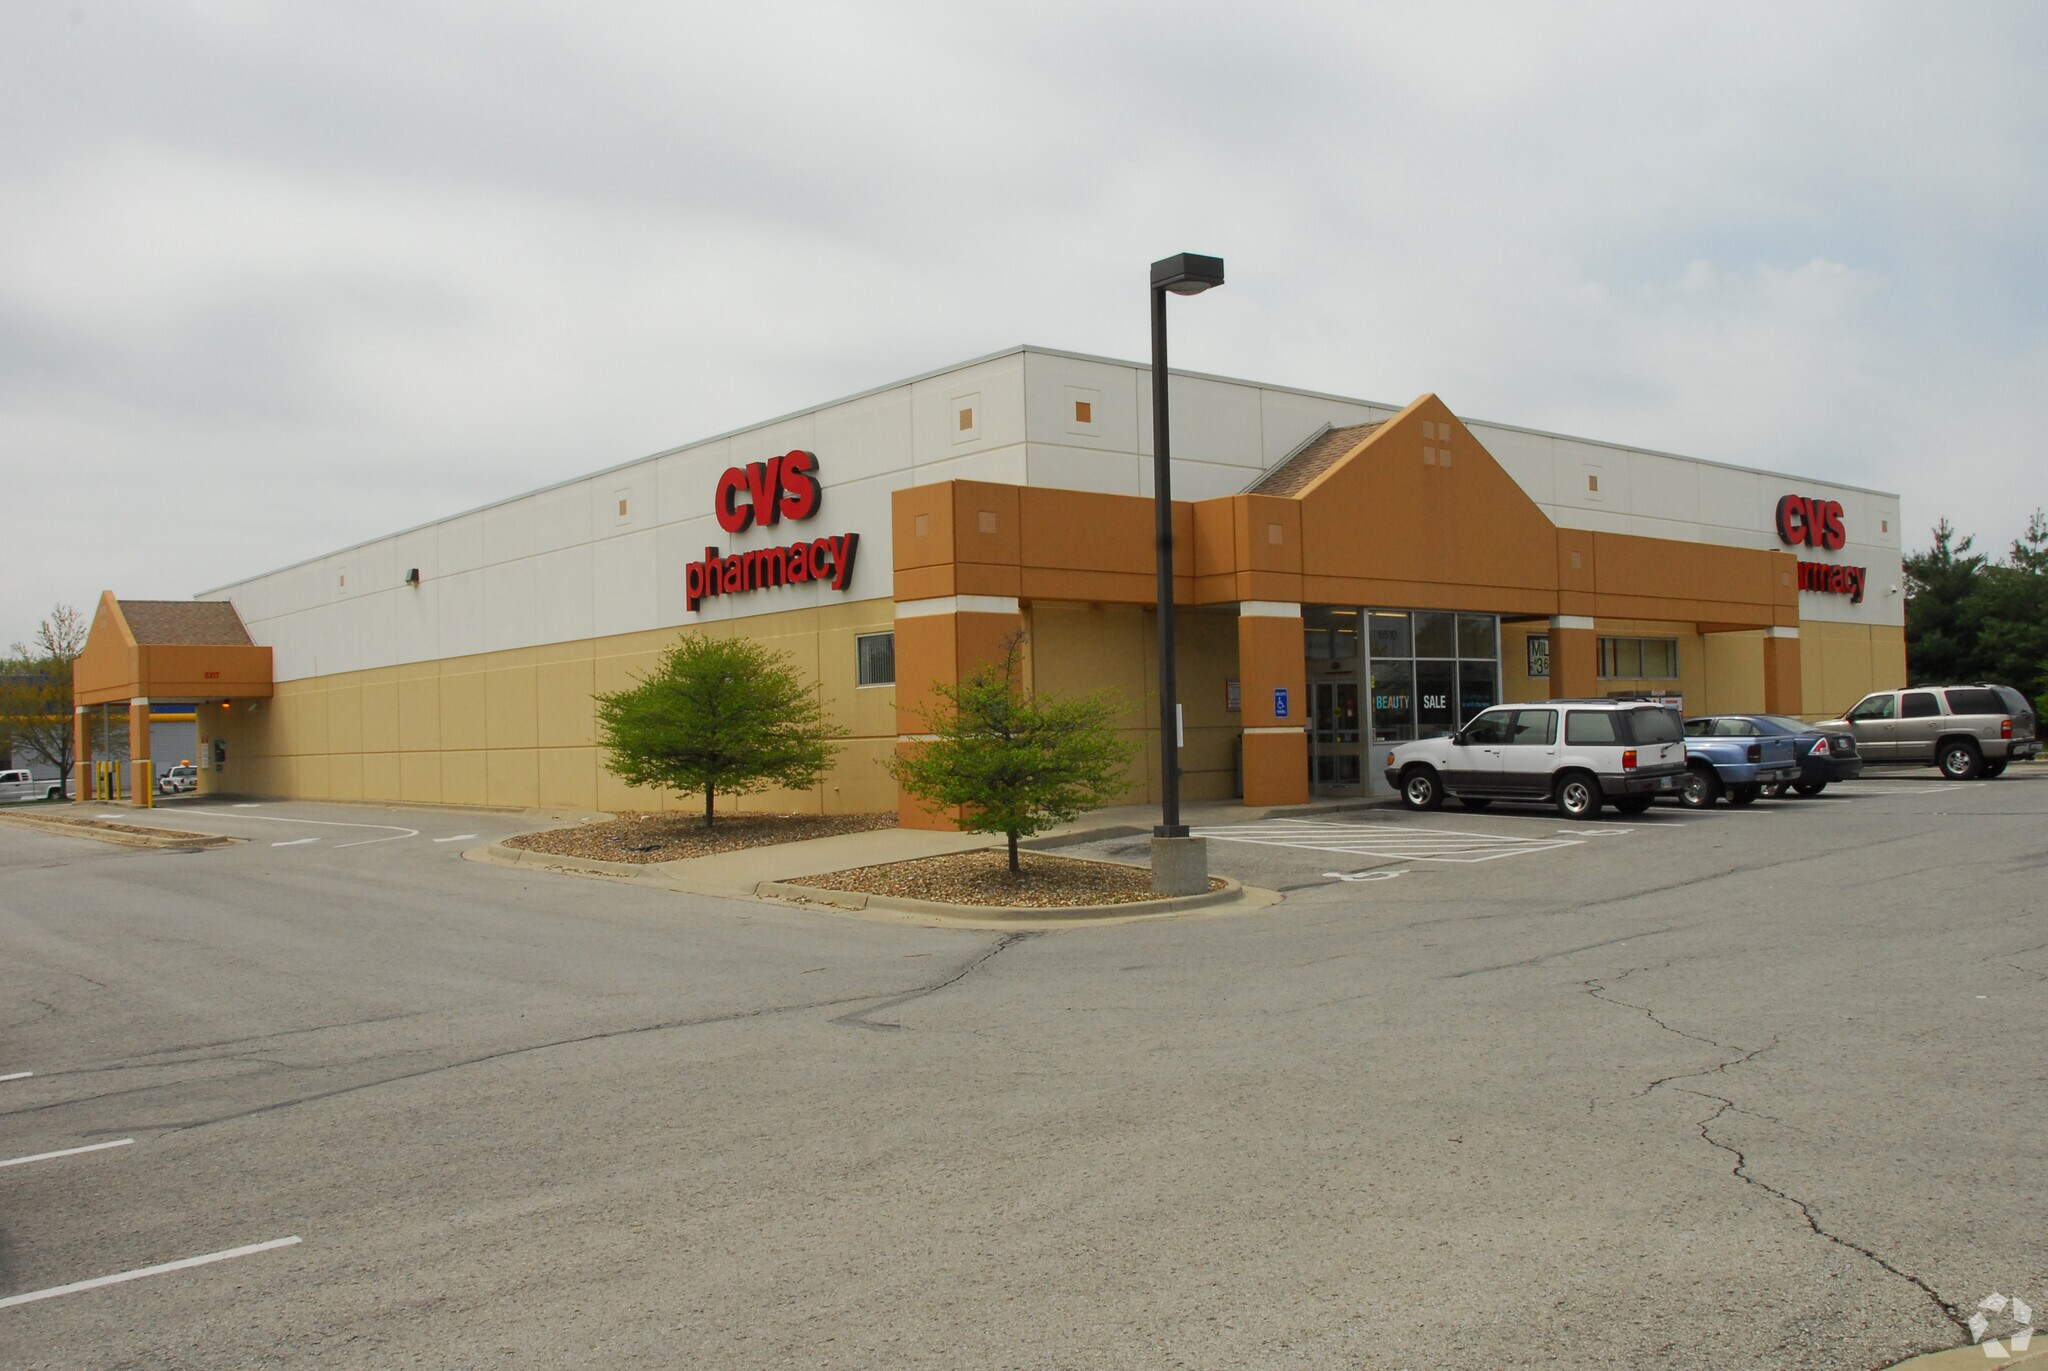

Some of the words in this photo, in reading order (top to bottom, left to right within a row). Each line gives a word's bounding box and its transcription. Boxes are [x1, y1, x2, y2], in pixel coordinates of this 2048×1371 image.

[715, 449, 822, 533] CVS
[1776, 494, 1846, 550] CVS
[686, 532, 859, 612] pharmacy
[1532, 640, 1549, 657] MIL
[204, 671, 221, 680] EXIT
[1376, 695, 1410, 709] BEAUTY
[1423, 694, 1446, 709] SALE
